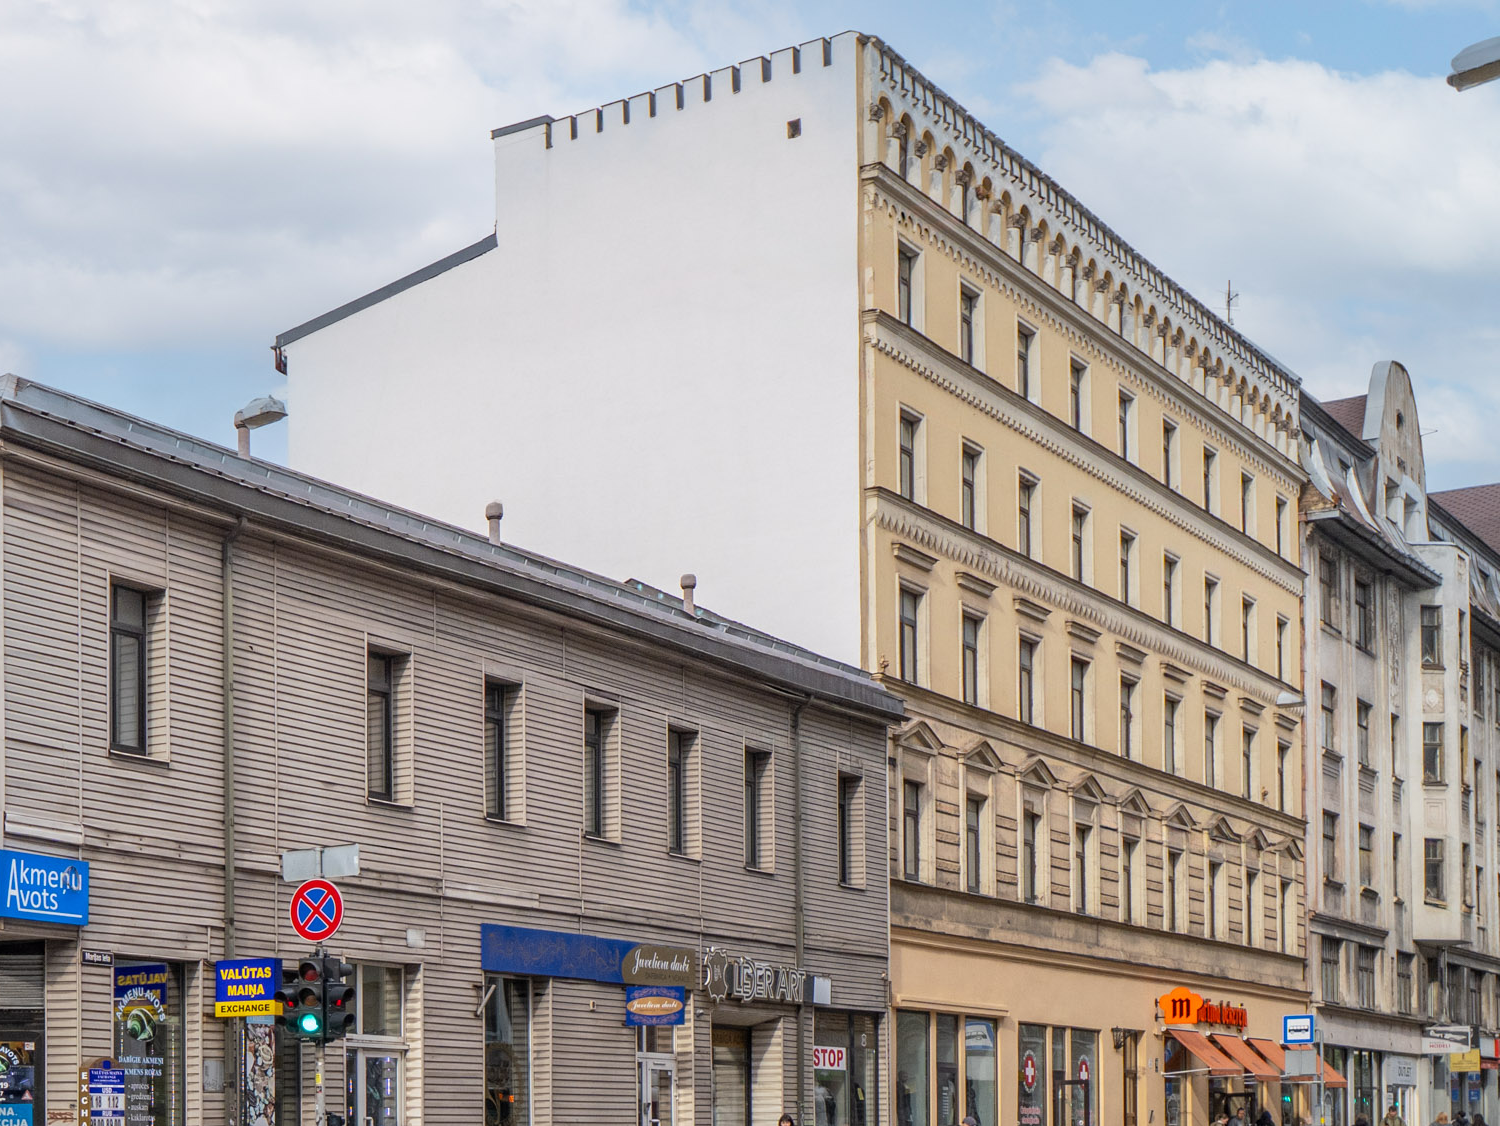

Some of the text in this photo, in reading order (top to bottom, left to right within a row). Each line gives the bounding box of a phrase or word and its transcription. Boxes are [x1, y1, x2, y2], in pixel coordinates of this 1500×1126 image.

[220, 966, 272, 980] VALŪTAS
[670, 954, 690, 973] darbi
[227, 984, 265, 998] MAIŅA
[776, 966, 806, 1002] ART
[116, 987, 143, 1020] AKMEŅU
[144, 989, 166, 1022] AVOTS
[221, 1003, 270, 1013] EXCHANGE
[0, 1046, 20, 1065] AVOTS
[119, 1055, 164, 1065] DABĪGIE AKMEŅI
[813, 1048, 844, 1067] STOP
